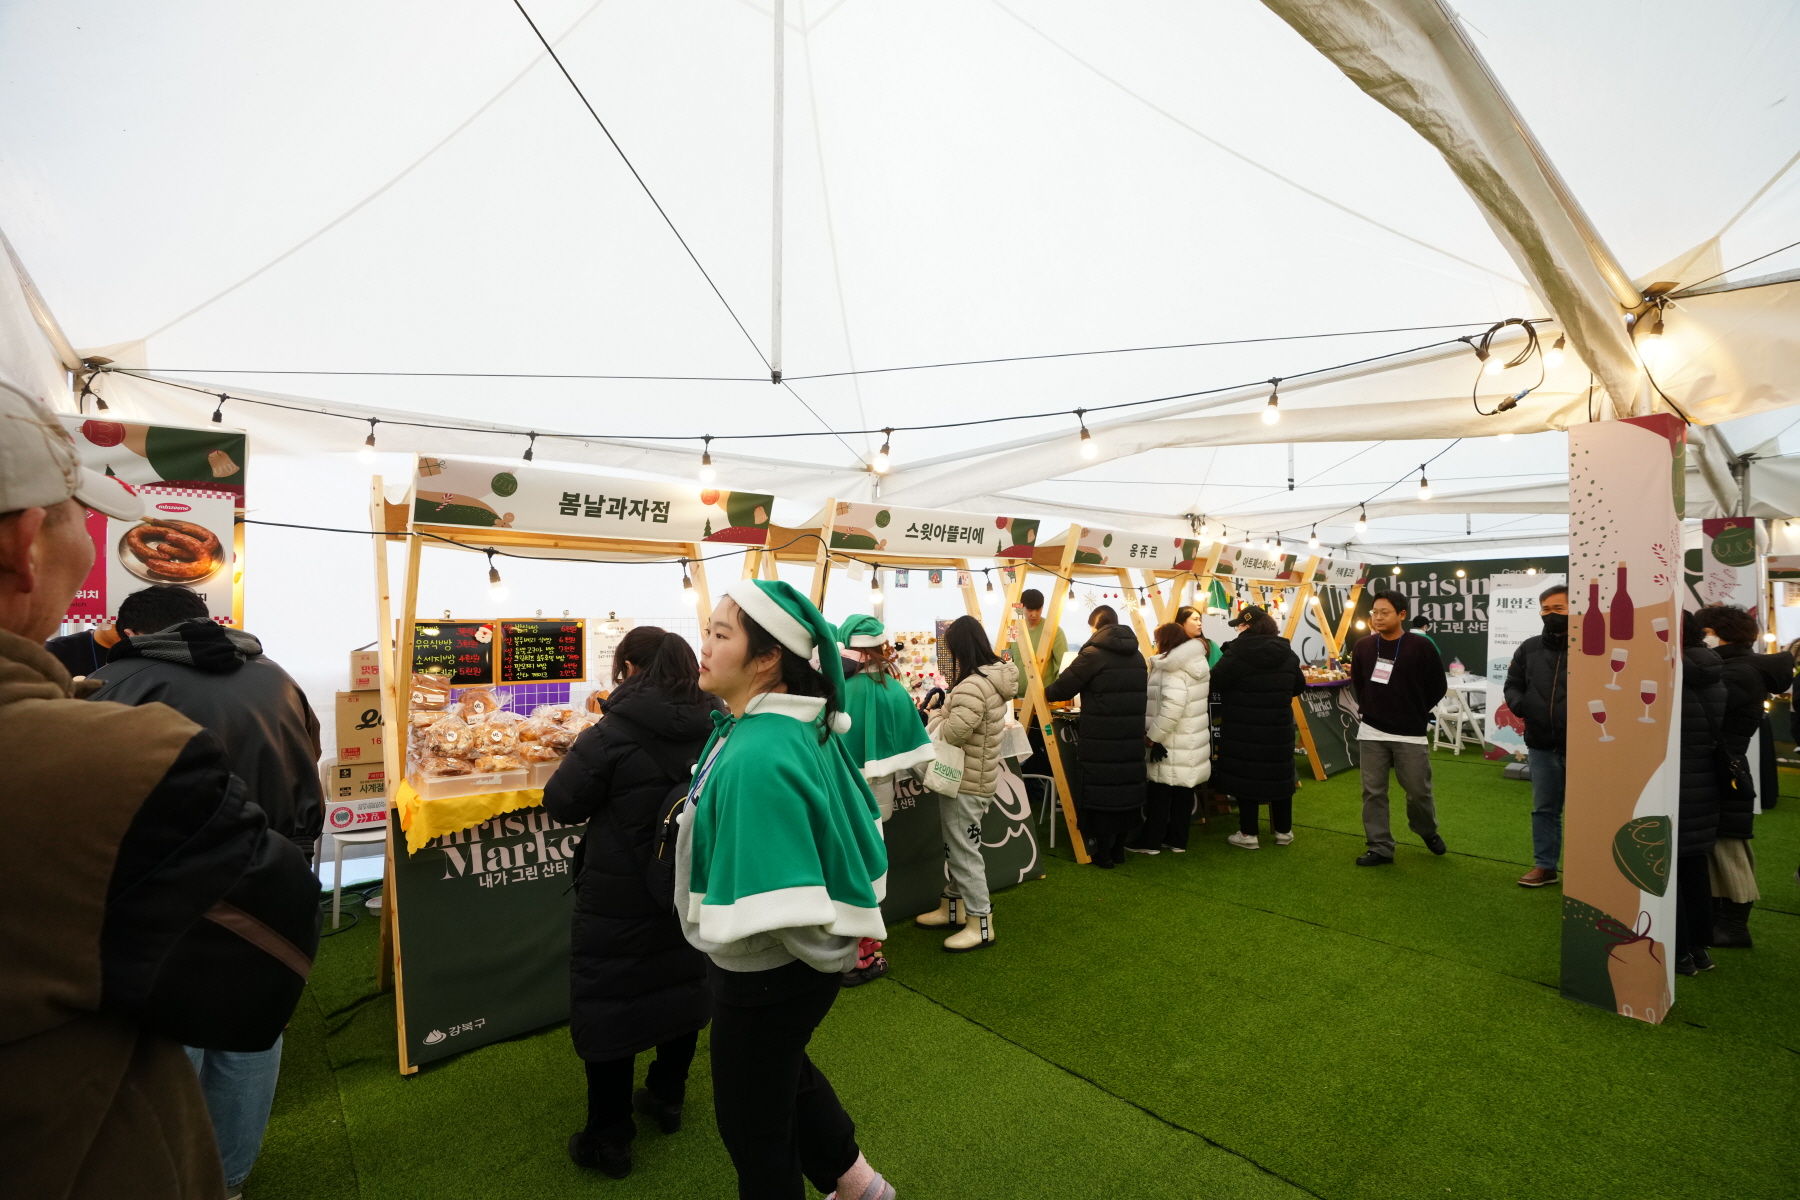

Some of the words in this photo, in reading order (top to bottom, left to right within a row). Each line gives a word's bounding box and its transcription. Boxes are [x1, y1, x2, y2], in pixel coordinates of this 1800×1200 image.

[559, 492, 670, 523] 봄날과자점
[905, 522, 984, 544] 스윗아뜰리에
[1130, 543, 1158, 558] 옹쥬르
[1366, 572, 1490, 598] Christm
[1495, 597, 1537, 609] 체험존
[1440, 622, 1464, 634] 그린
[415, 639, 453, 651] 우유식빵
[415, 654, 456, 665] 소세지빵
[440, 830, 584, 880] Marke
[479, 869, 508, 889] 내가
[511, 863, 539, 882] 그린
[542, 859, 569, 878] 산타
[448, 1017, 486, 1037] 강북구
